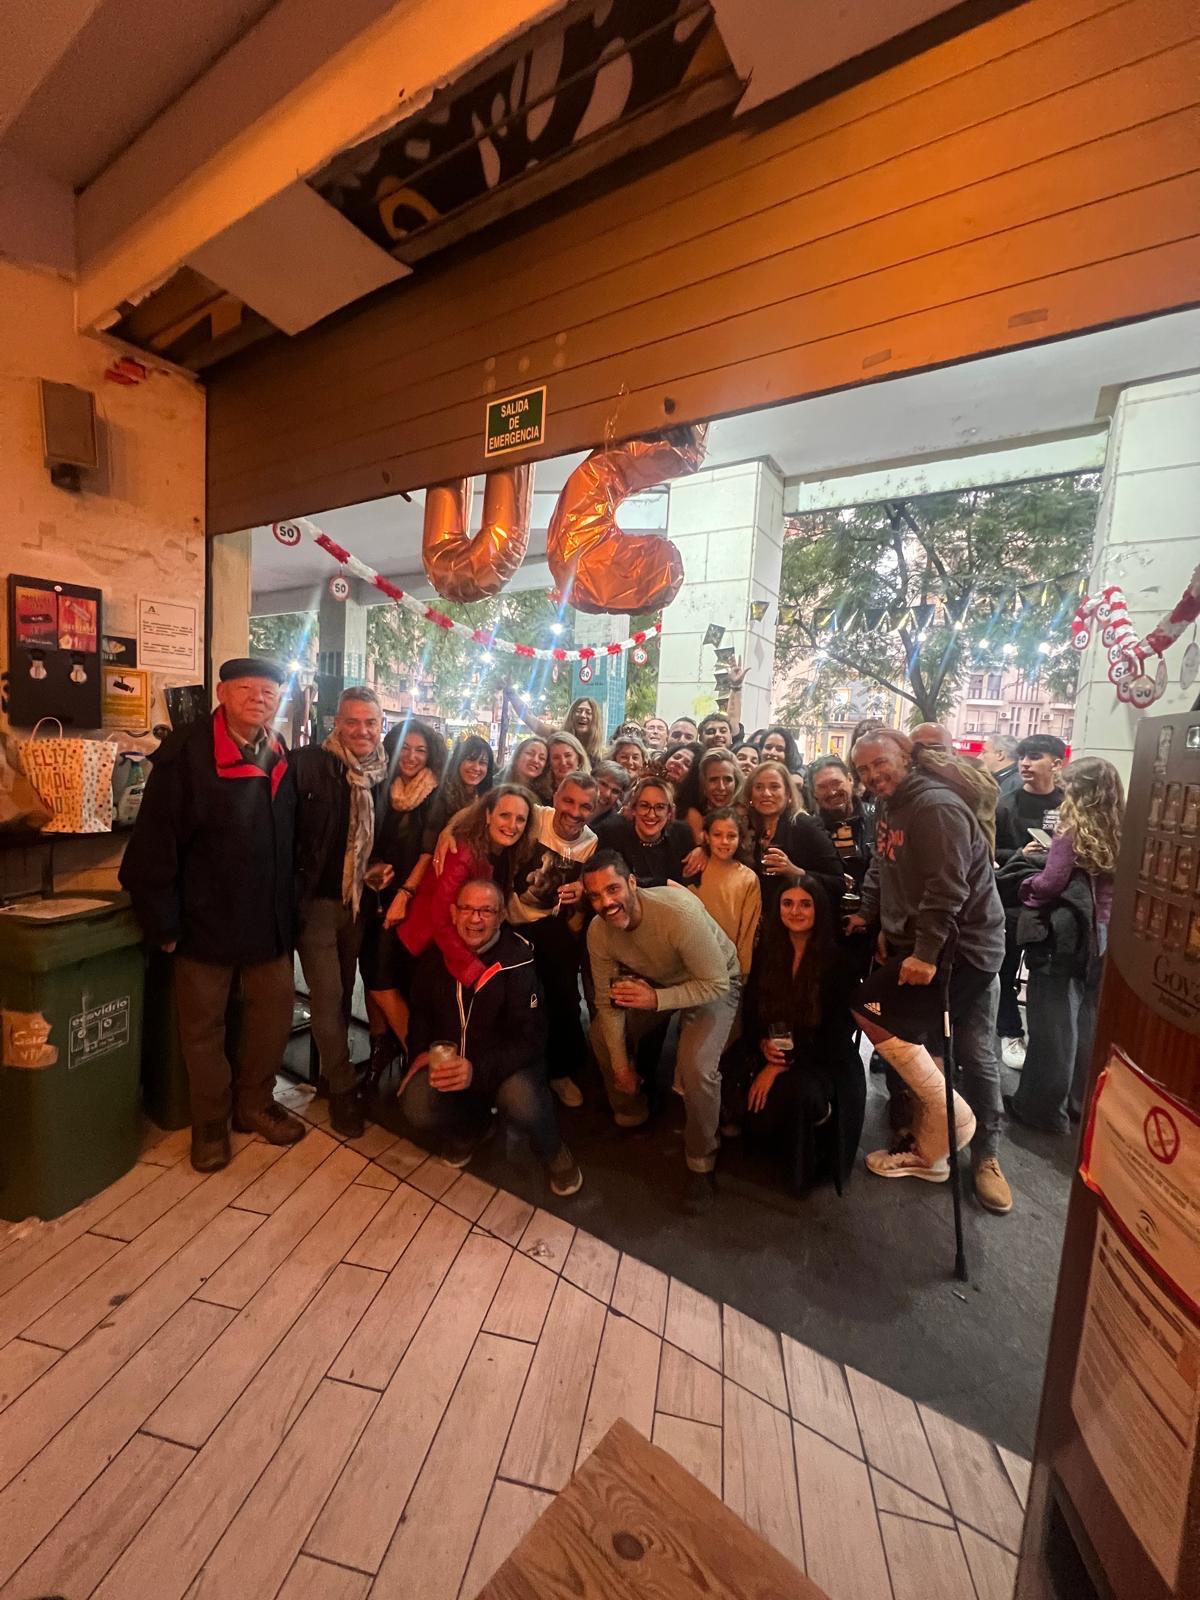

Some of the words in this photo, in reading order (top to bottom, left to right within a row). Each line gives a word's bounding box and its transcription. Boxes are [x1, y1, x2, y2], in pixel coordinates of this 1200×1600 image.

[500, 398, 529, 418] SALIDA
[508, 416, 520, 430] DE
[488, 425, 540, 450] EMERGENCIA
[279, 526, 295, 538] 50
[334, 583, 346, 593] 50
[1098, 606, 1110, 617] 50
